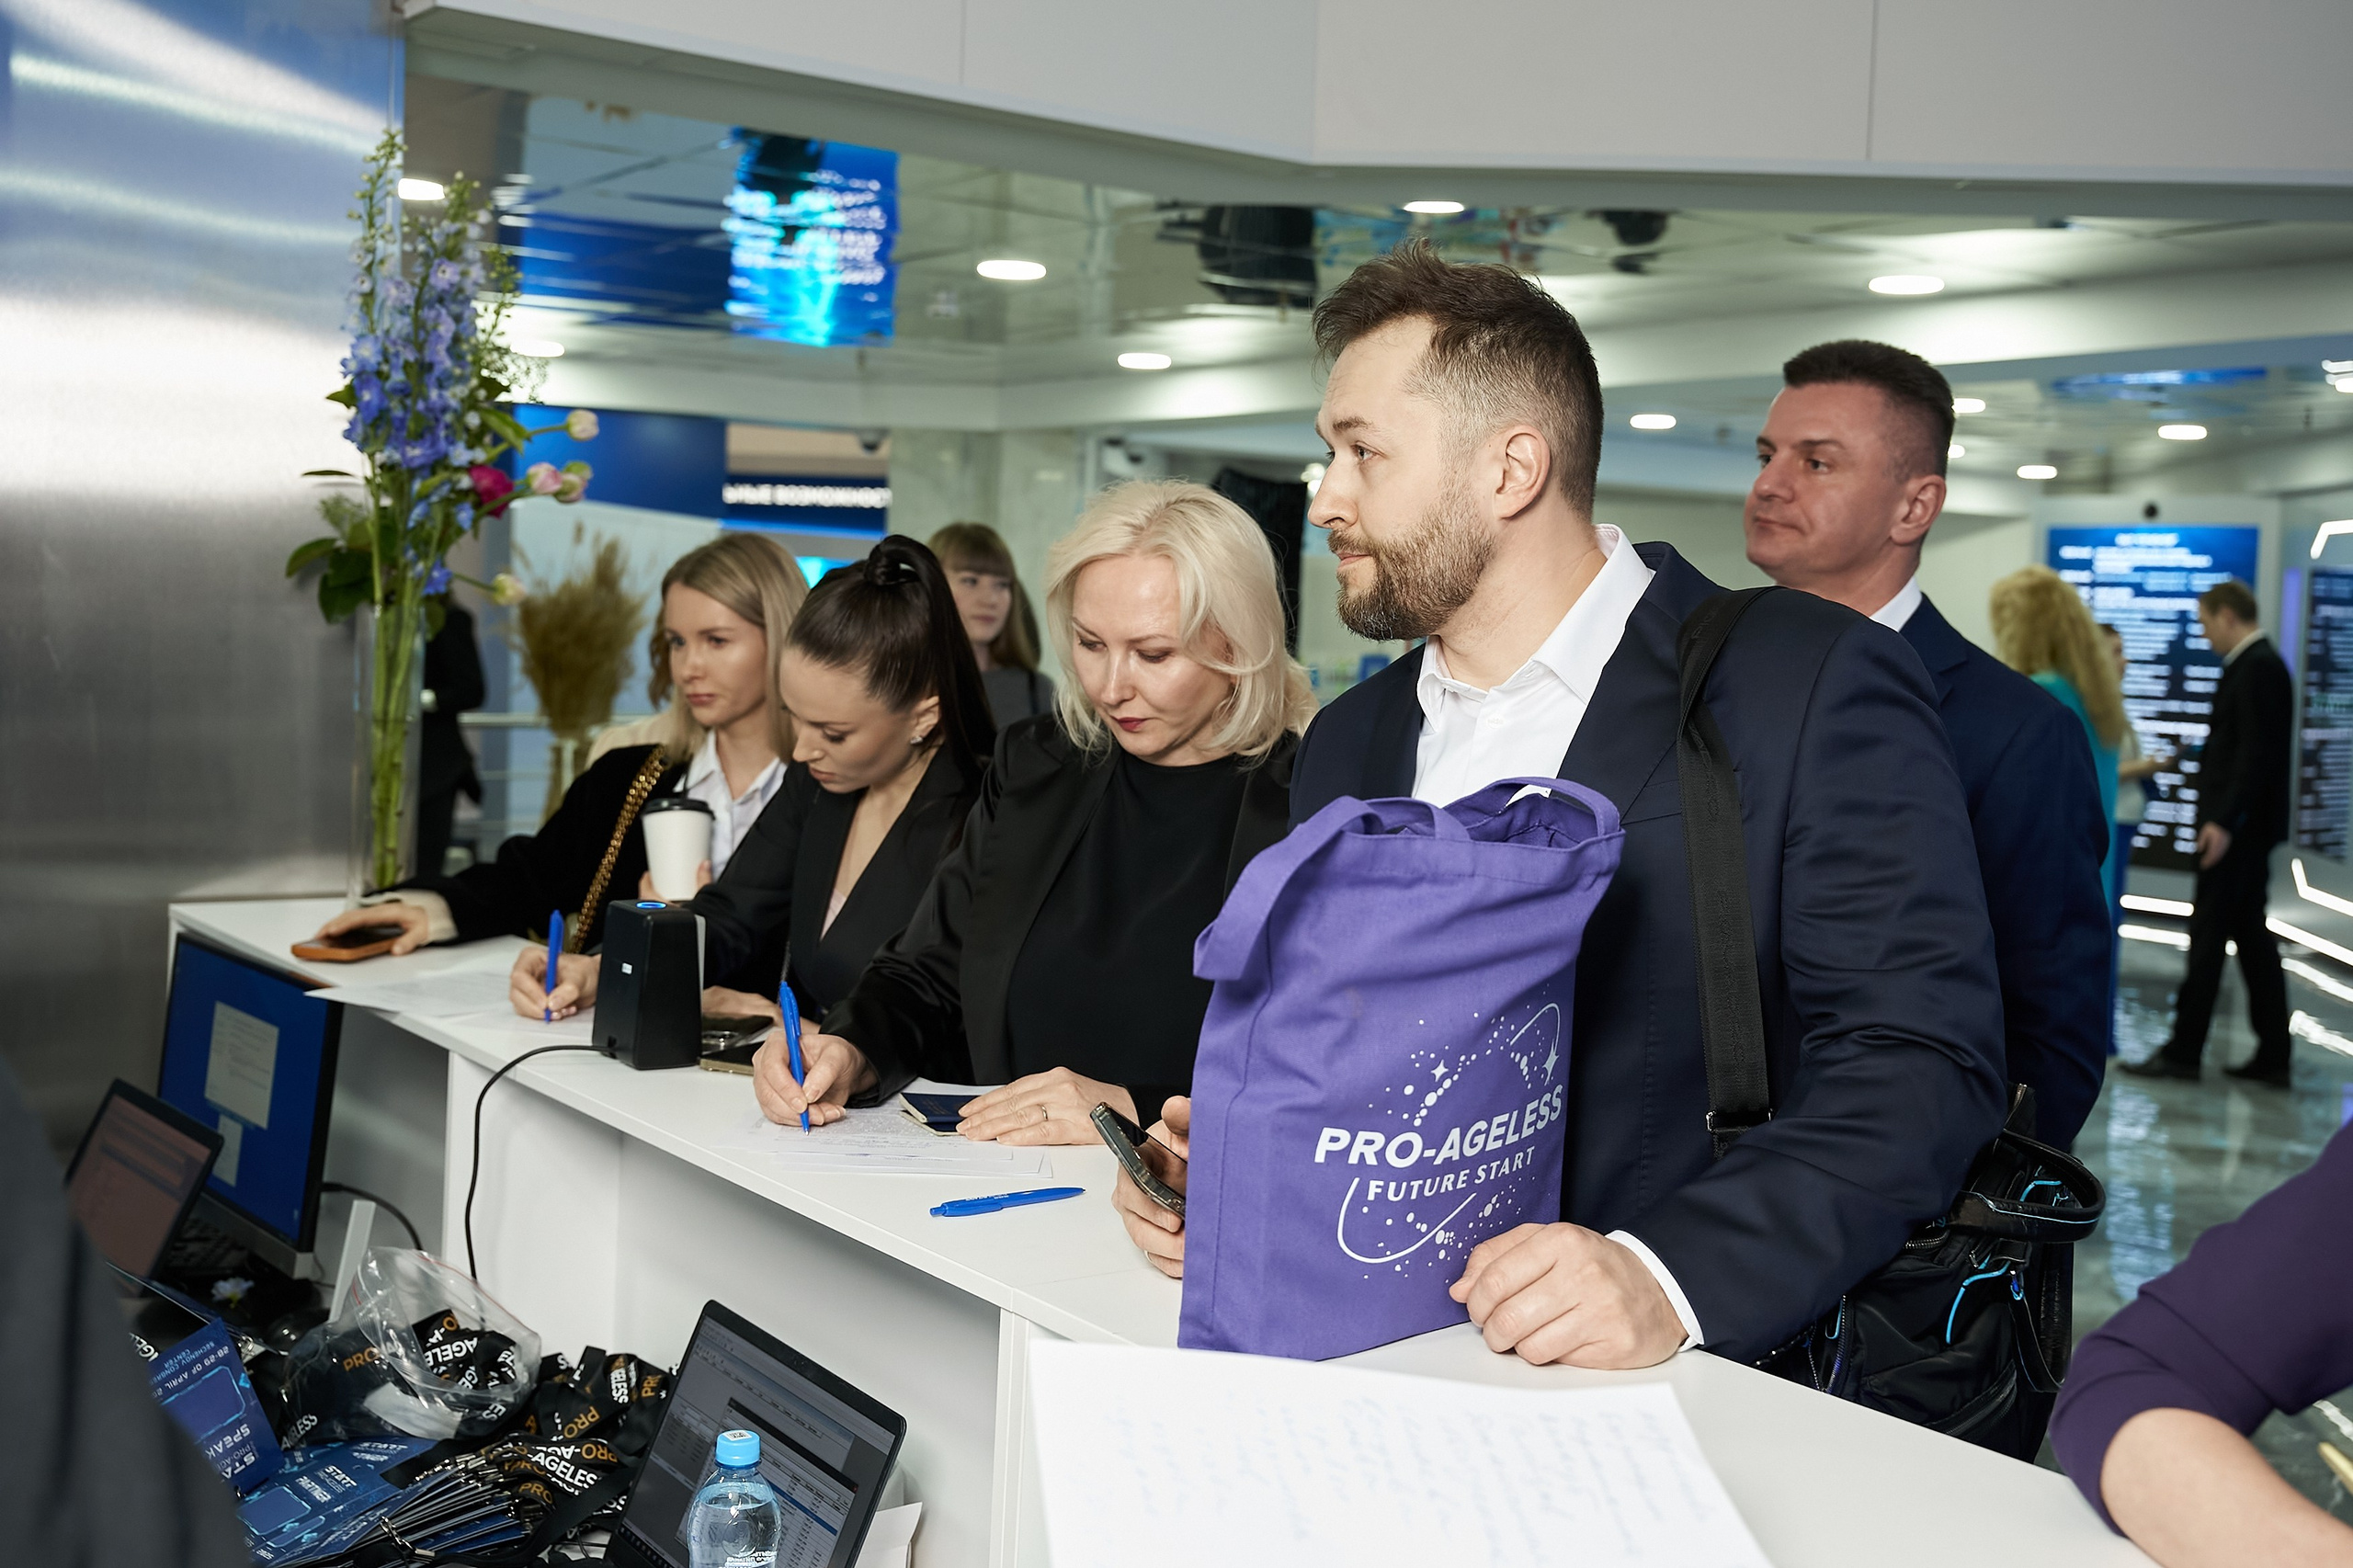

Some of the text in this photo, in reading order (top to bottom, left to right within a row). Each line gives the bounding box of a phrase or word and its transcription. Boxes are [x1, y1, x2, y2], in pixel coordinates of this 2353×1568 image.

[1314, 1084, 1563, 1167] PRO-AGELESS
[1367, 1146, 1535, 1201] FUTURE START
[424, 1336, 478, 1367] AGELE
[164, 1370, 189, 1390] APRIL
[204, 1423, 251, 1459] SPEAK
[221, 1451, 256, 1480] STA
[324, 1465, 358, 1488] START
